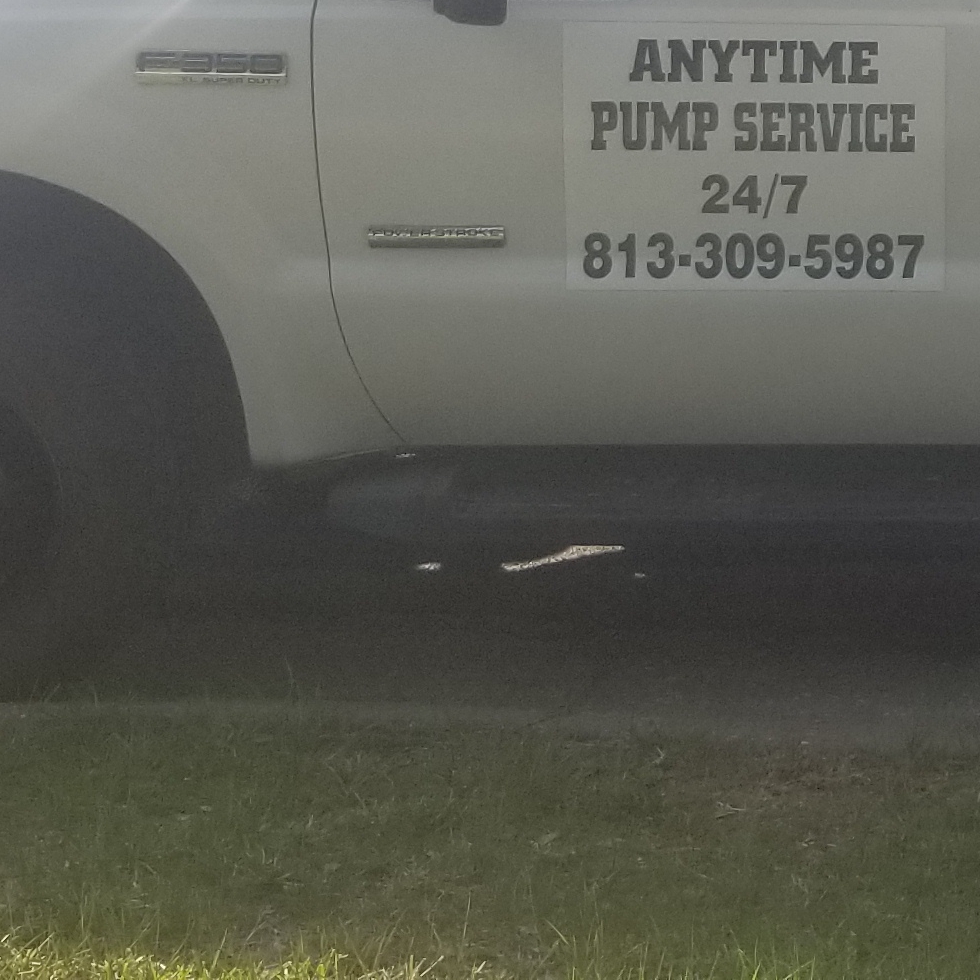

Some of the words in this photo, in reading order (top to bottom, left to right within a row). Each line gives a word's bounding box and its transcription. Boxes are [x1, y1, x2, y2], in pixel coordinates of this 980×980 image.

[202, 76, 244, 85] SUPER
[247, 77, 282, 85] DUTY
[629, 38, 879, 84] ANYTIME
[590, 101, 719, 151] PUMP
[733, 102, 916, 153] SERVICE
[701, 173, 808, 219] 24/7
[583, 232, 925, 279] 813-309-5987
